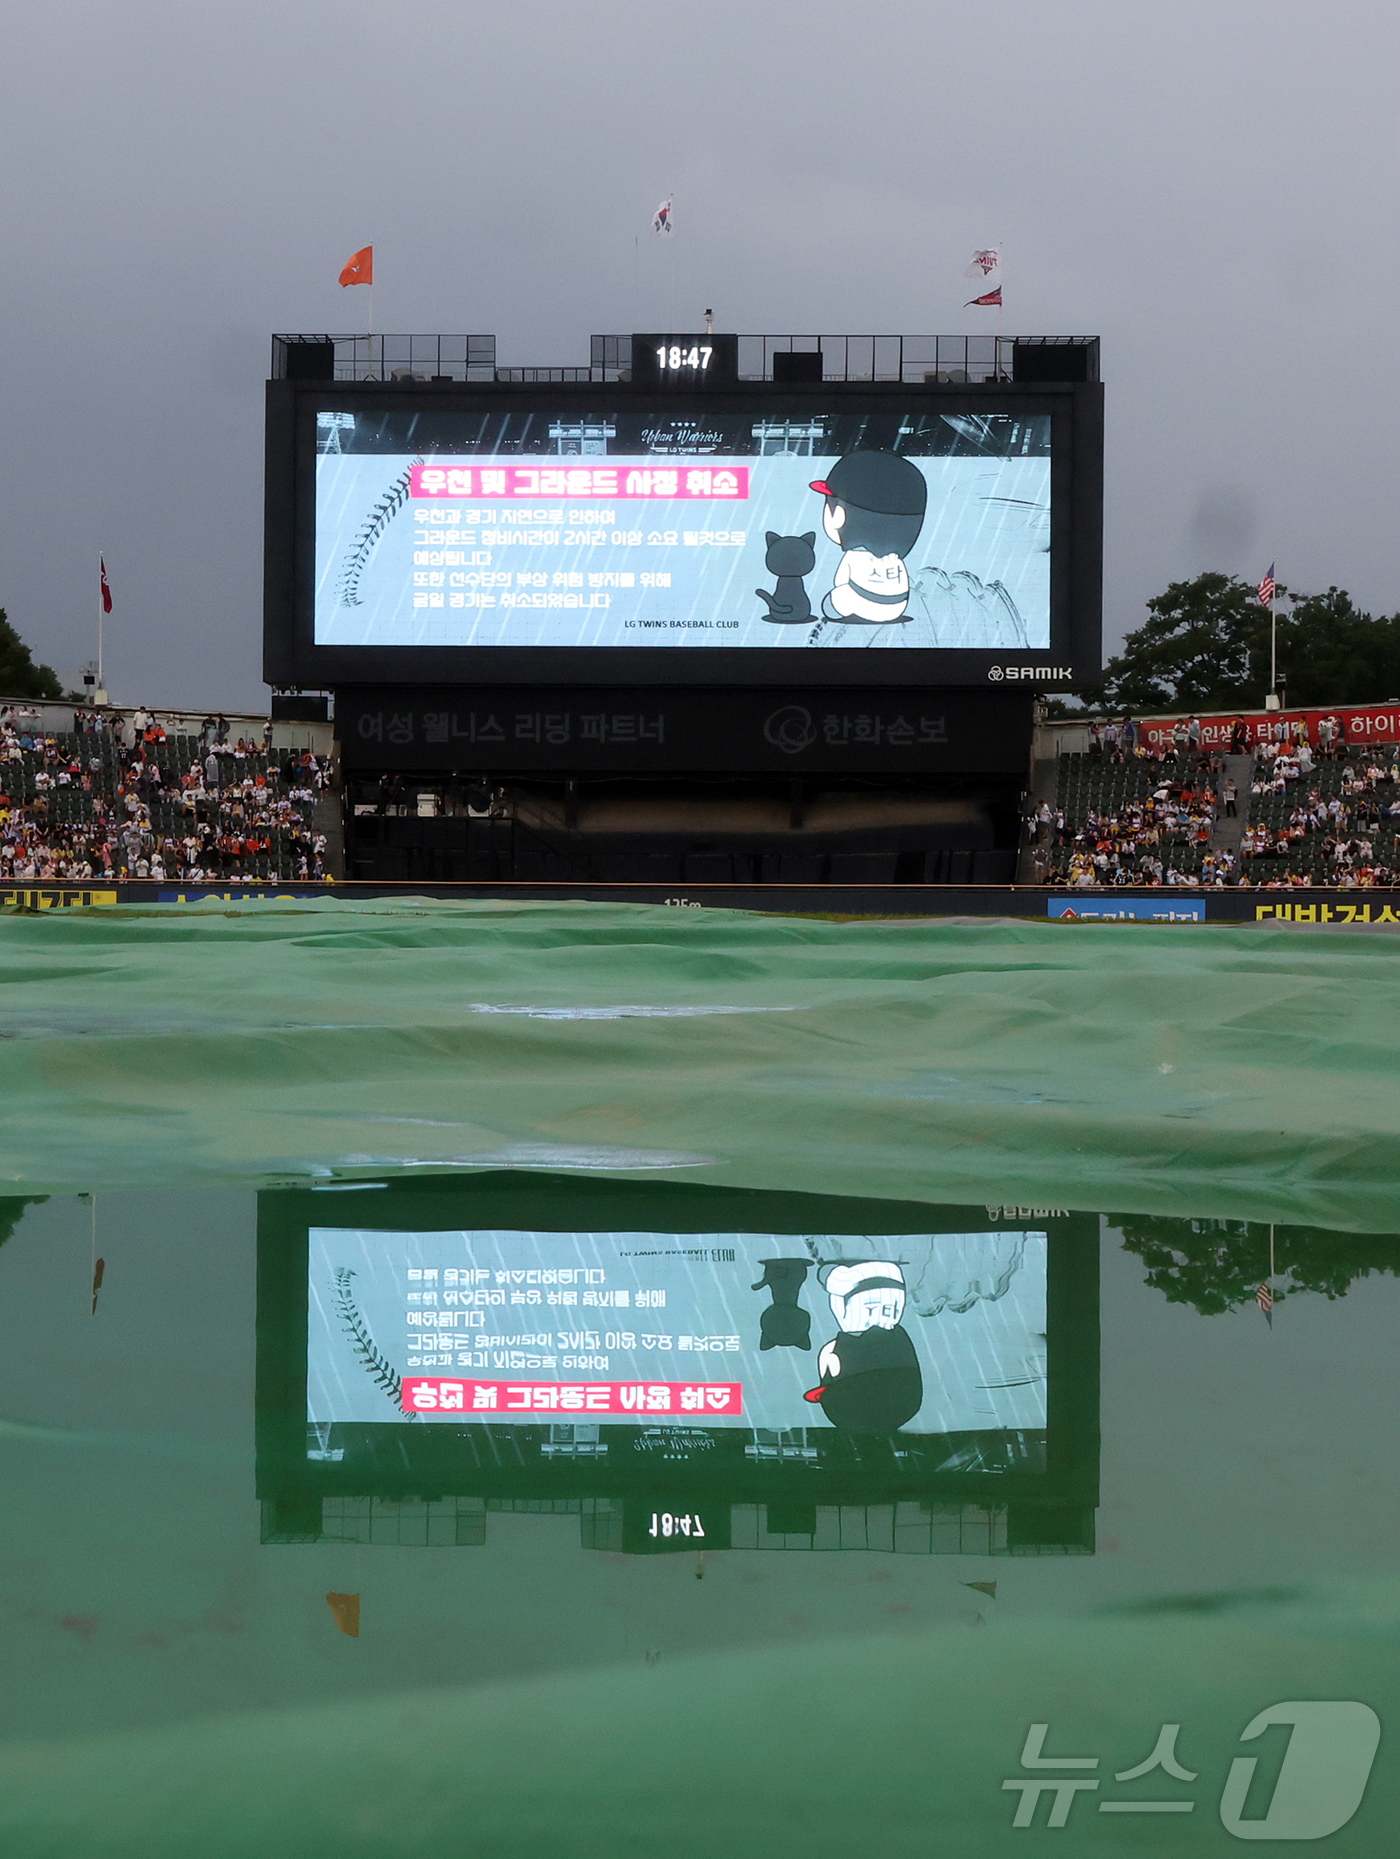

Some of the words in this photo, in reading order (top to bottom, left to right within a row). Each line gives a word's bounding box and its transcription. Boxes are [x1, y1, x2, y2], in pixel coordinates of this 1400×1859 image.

[656, 346, 712, 369] 18:47
[641, 429, 673, 444] Urban
[674, 429, 723, 445] Warriors
[420, 470, 472, 495] 우천
[480, 470, 506, 495] 및
[514, 470, 618, 495] 그라운드
[626, 470, 678, 495] 사정
[686, 470, 738, 495] 취소
[413, 509, 461, 525] 우천과
[465, 509, 497, 525] 경기
[501, 509, 564, 525] 지연으로
[568, 509, 616, 525] 인하여
[413, 530, 476, 546] 그라운드
[480, 530, 560, 546] 정비시간이
[563, 530, 607, 546] 2시간
[611, 530, 643, 546] 이상
[647, 530, 679, 546] 소요
[683, 530, 746, 546] 될것으로
[413, 551, 492, 566] 예상됩니다
[413, 571, 445, 587] 또한
[449, 571, 512, 587] 선수단의
[516, 571, 548, 587] 부상
[552, 571, 584, 587] 위험
[588, 571, 635, 587] 방지를
[639, 571, 671, 587] 위해
[868, 565, 903, 584] 스타
[413, 592, 445, 608] 금일
[449, 592, 496, 608] 경기는
[500, 592, 611, 608] 취소되었습니다
[624, 620, 635, 629] LG
[638, 620, 668, 629] TWINS
[670, 620, 714, 629] BASEBALL
[716, 620, 739, 629] CLUB
[1005, 667, 1072, 680] SAMIK
[357, 713, 414, 744] 여성
[421, 713, 505, 744] 웰니스
[515, 713, 571, 744] 리딩
[580, 713, 665, 744] 파트너
[823, 714, 948, 746] 한화손보
